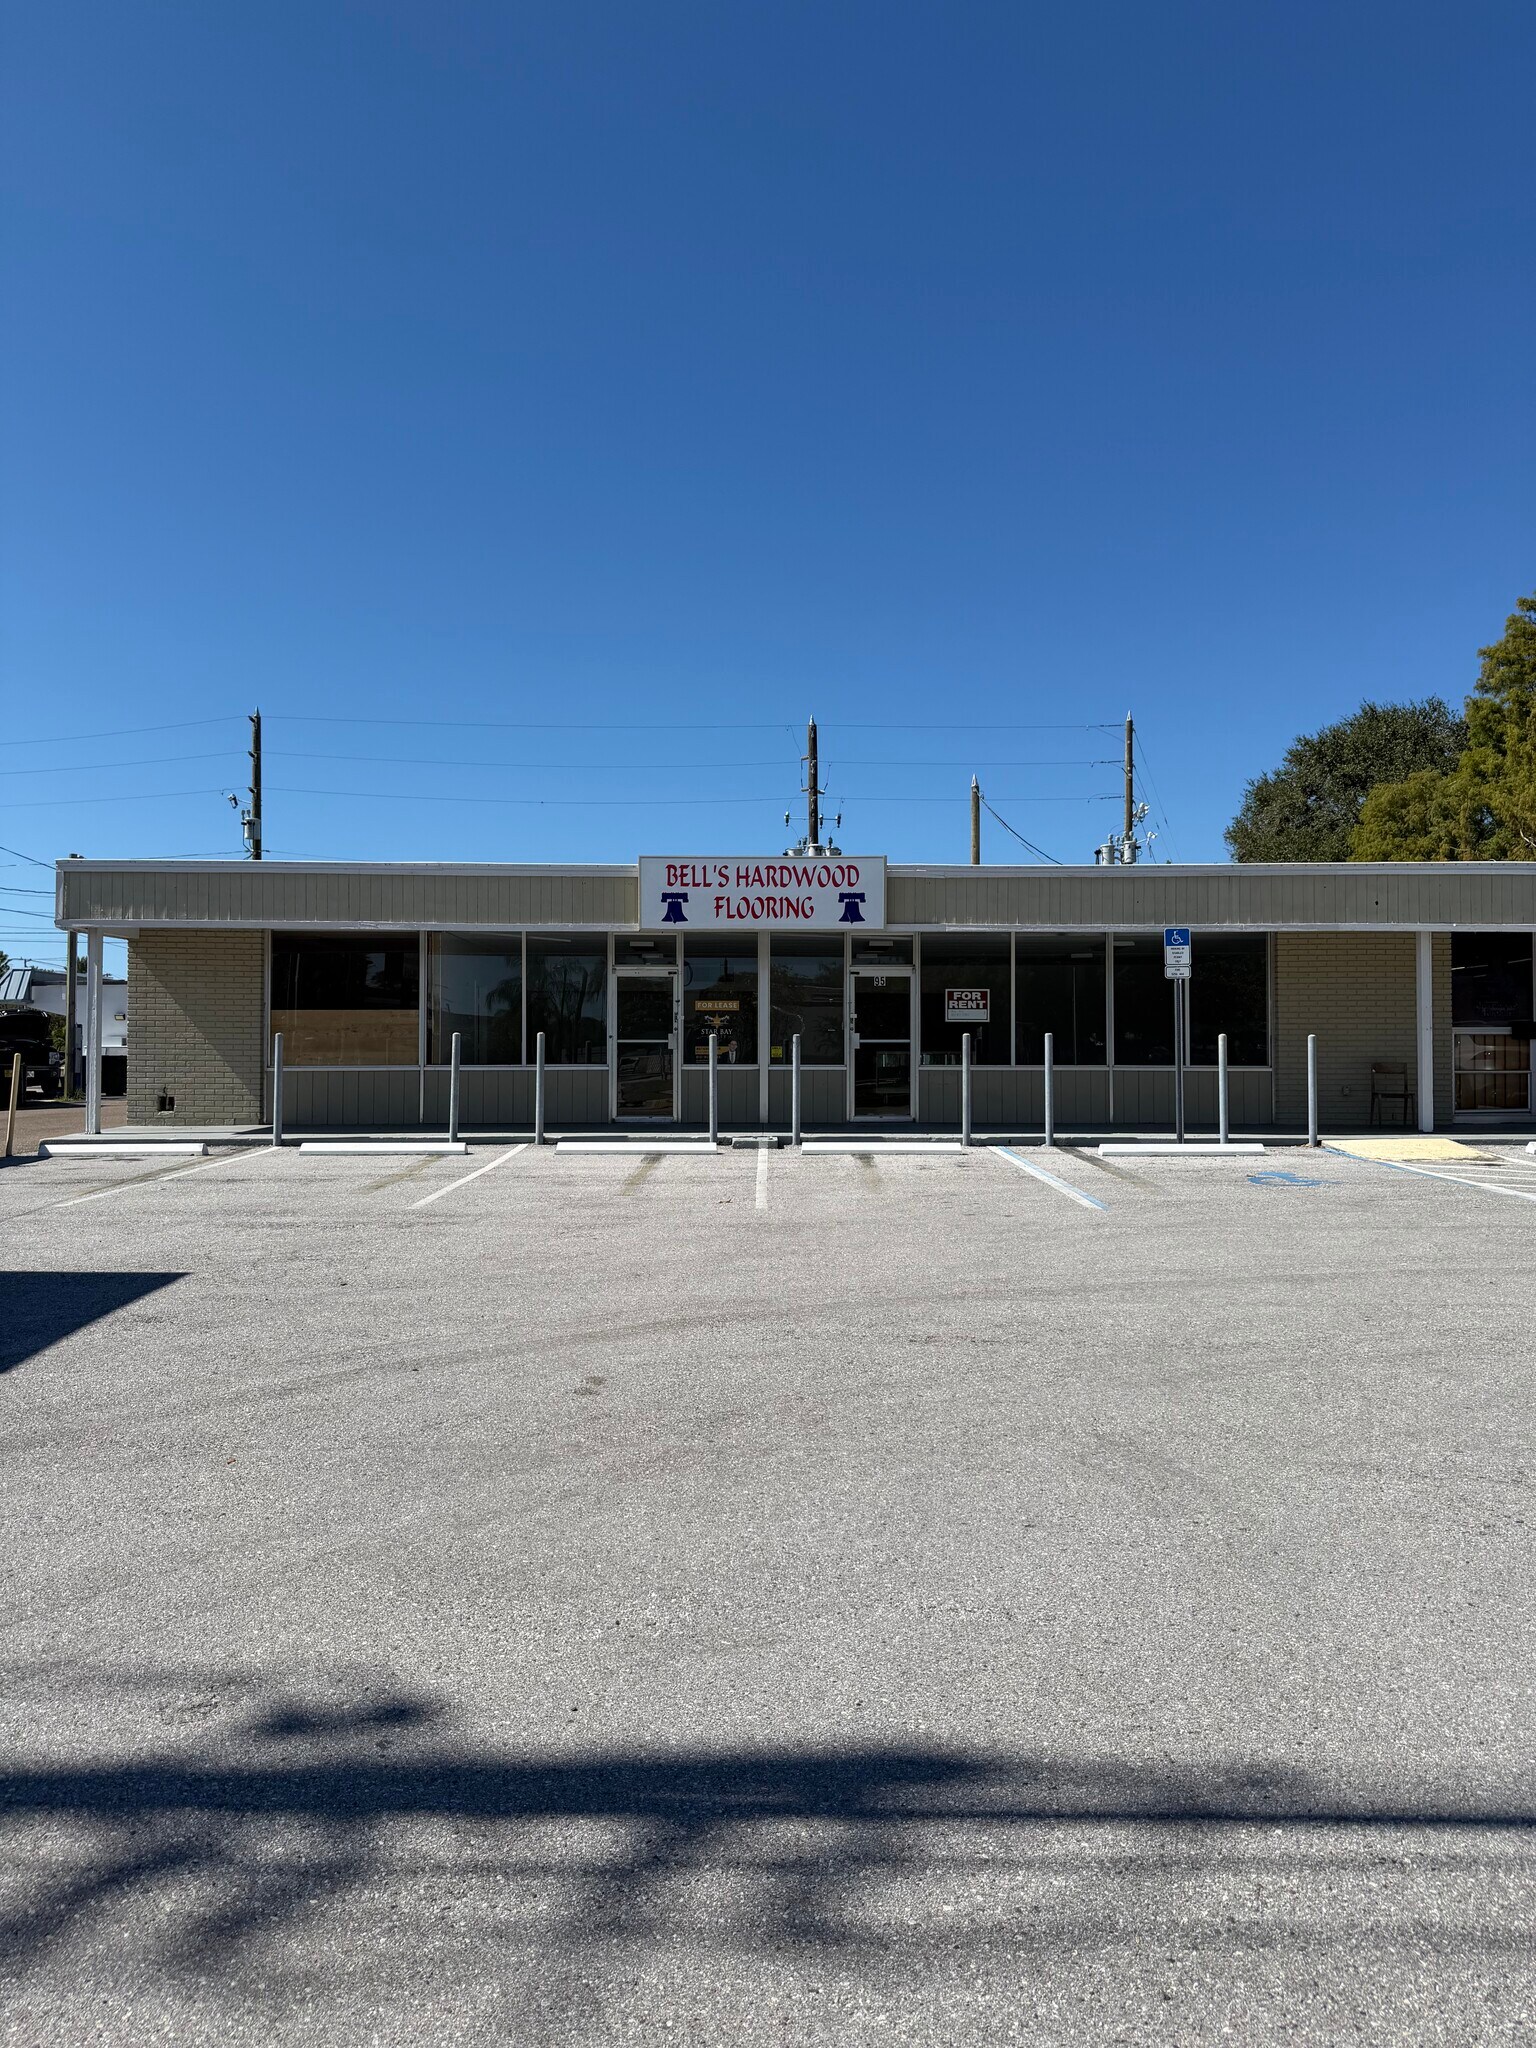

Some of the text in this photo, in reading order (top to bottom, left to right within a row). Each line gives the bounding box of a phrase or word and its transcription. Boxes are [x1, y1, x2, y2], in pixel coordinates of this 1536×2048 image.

[665, 864, 860, 888] BELL'S HARDWOOD
[713, 896, 815, 920] FLOORING
[874, 976, 885, 986] 95
[953, 991, 981, 1000] FOR
[949, 1000, 986, 1009] RENT
